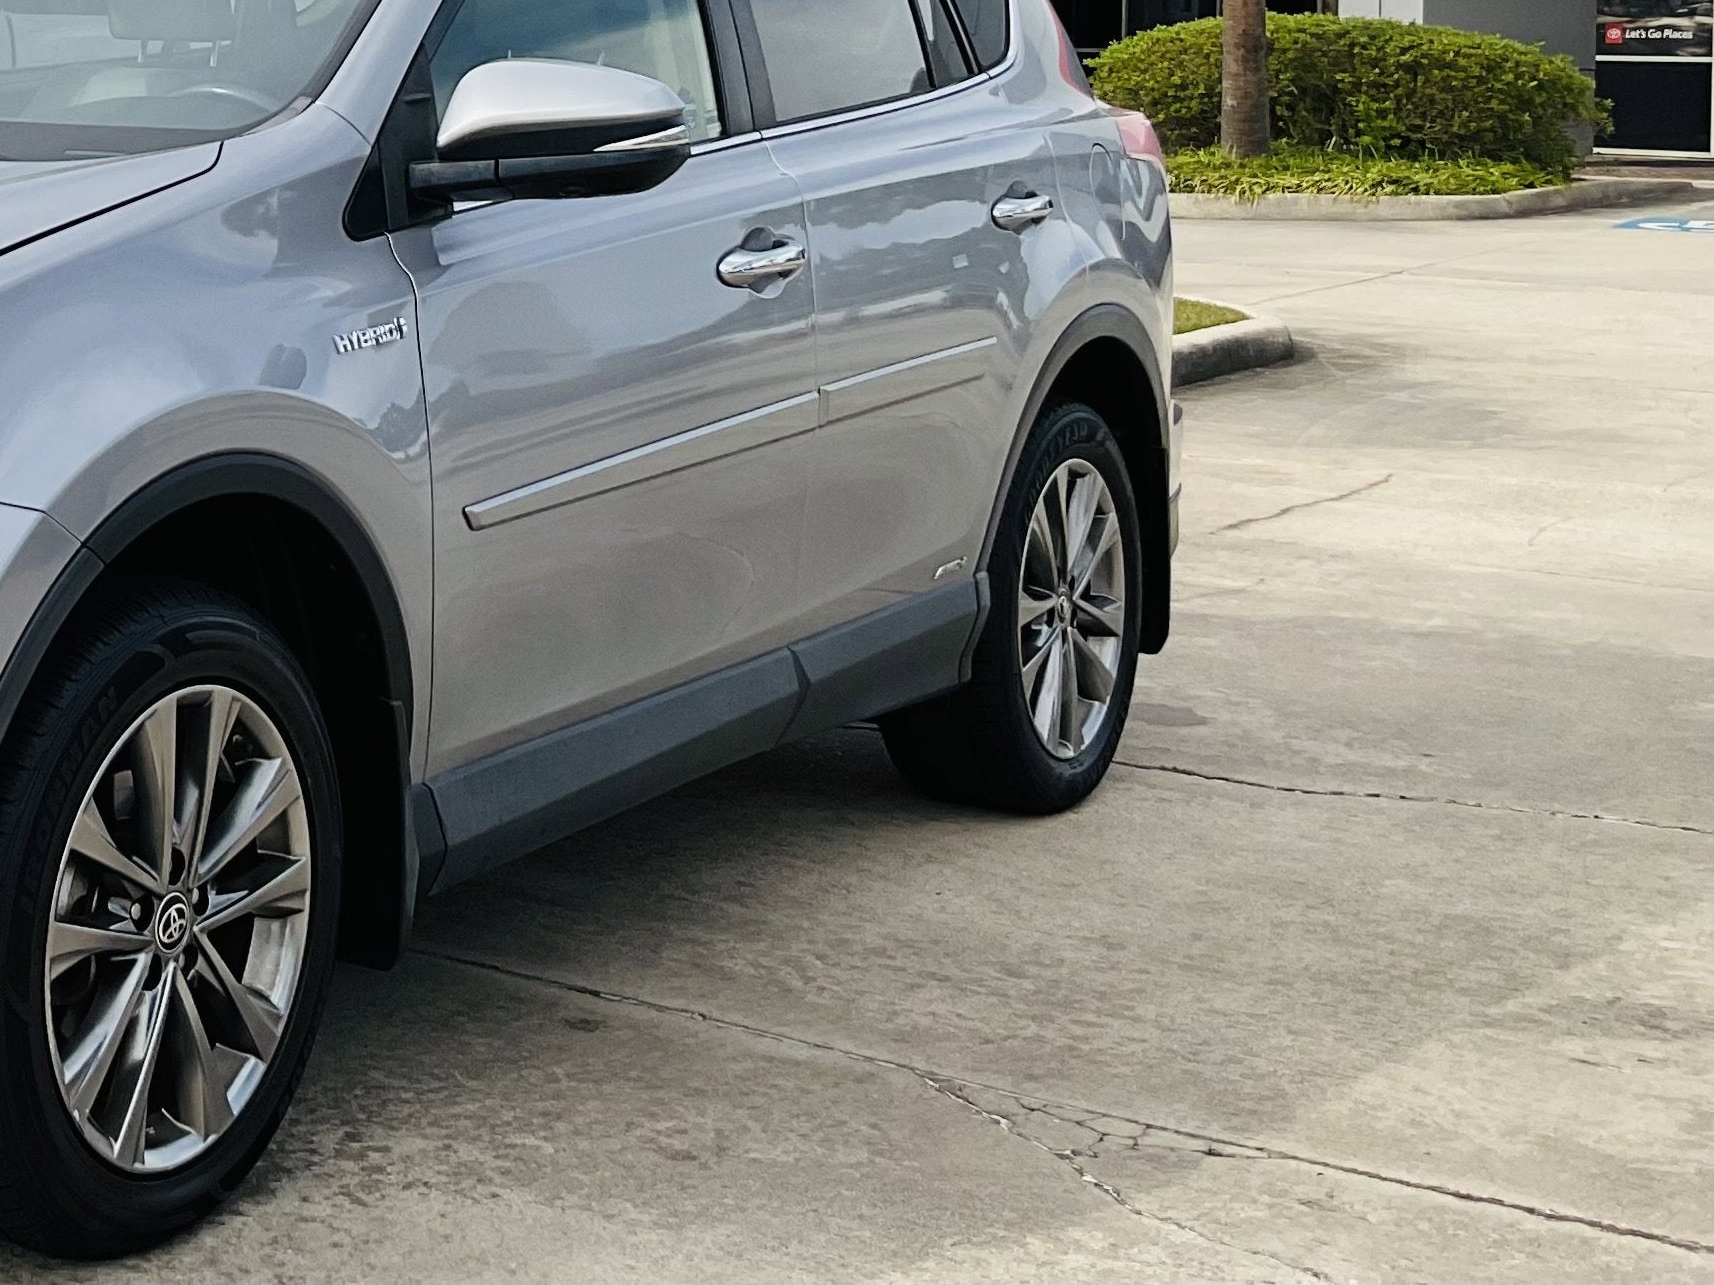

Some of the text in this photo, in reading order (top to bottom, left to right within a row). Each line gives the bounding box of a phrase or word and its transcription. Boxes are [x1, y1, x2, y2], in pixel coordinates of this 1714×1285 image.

[1625, 28, 1693, 39] Let's Go Places
[333, 322, 399, 354] HYBRID
